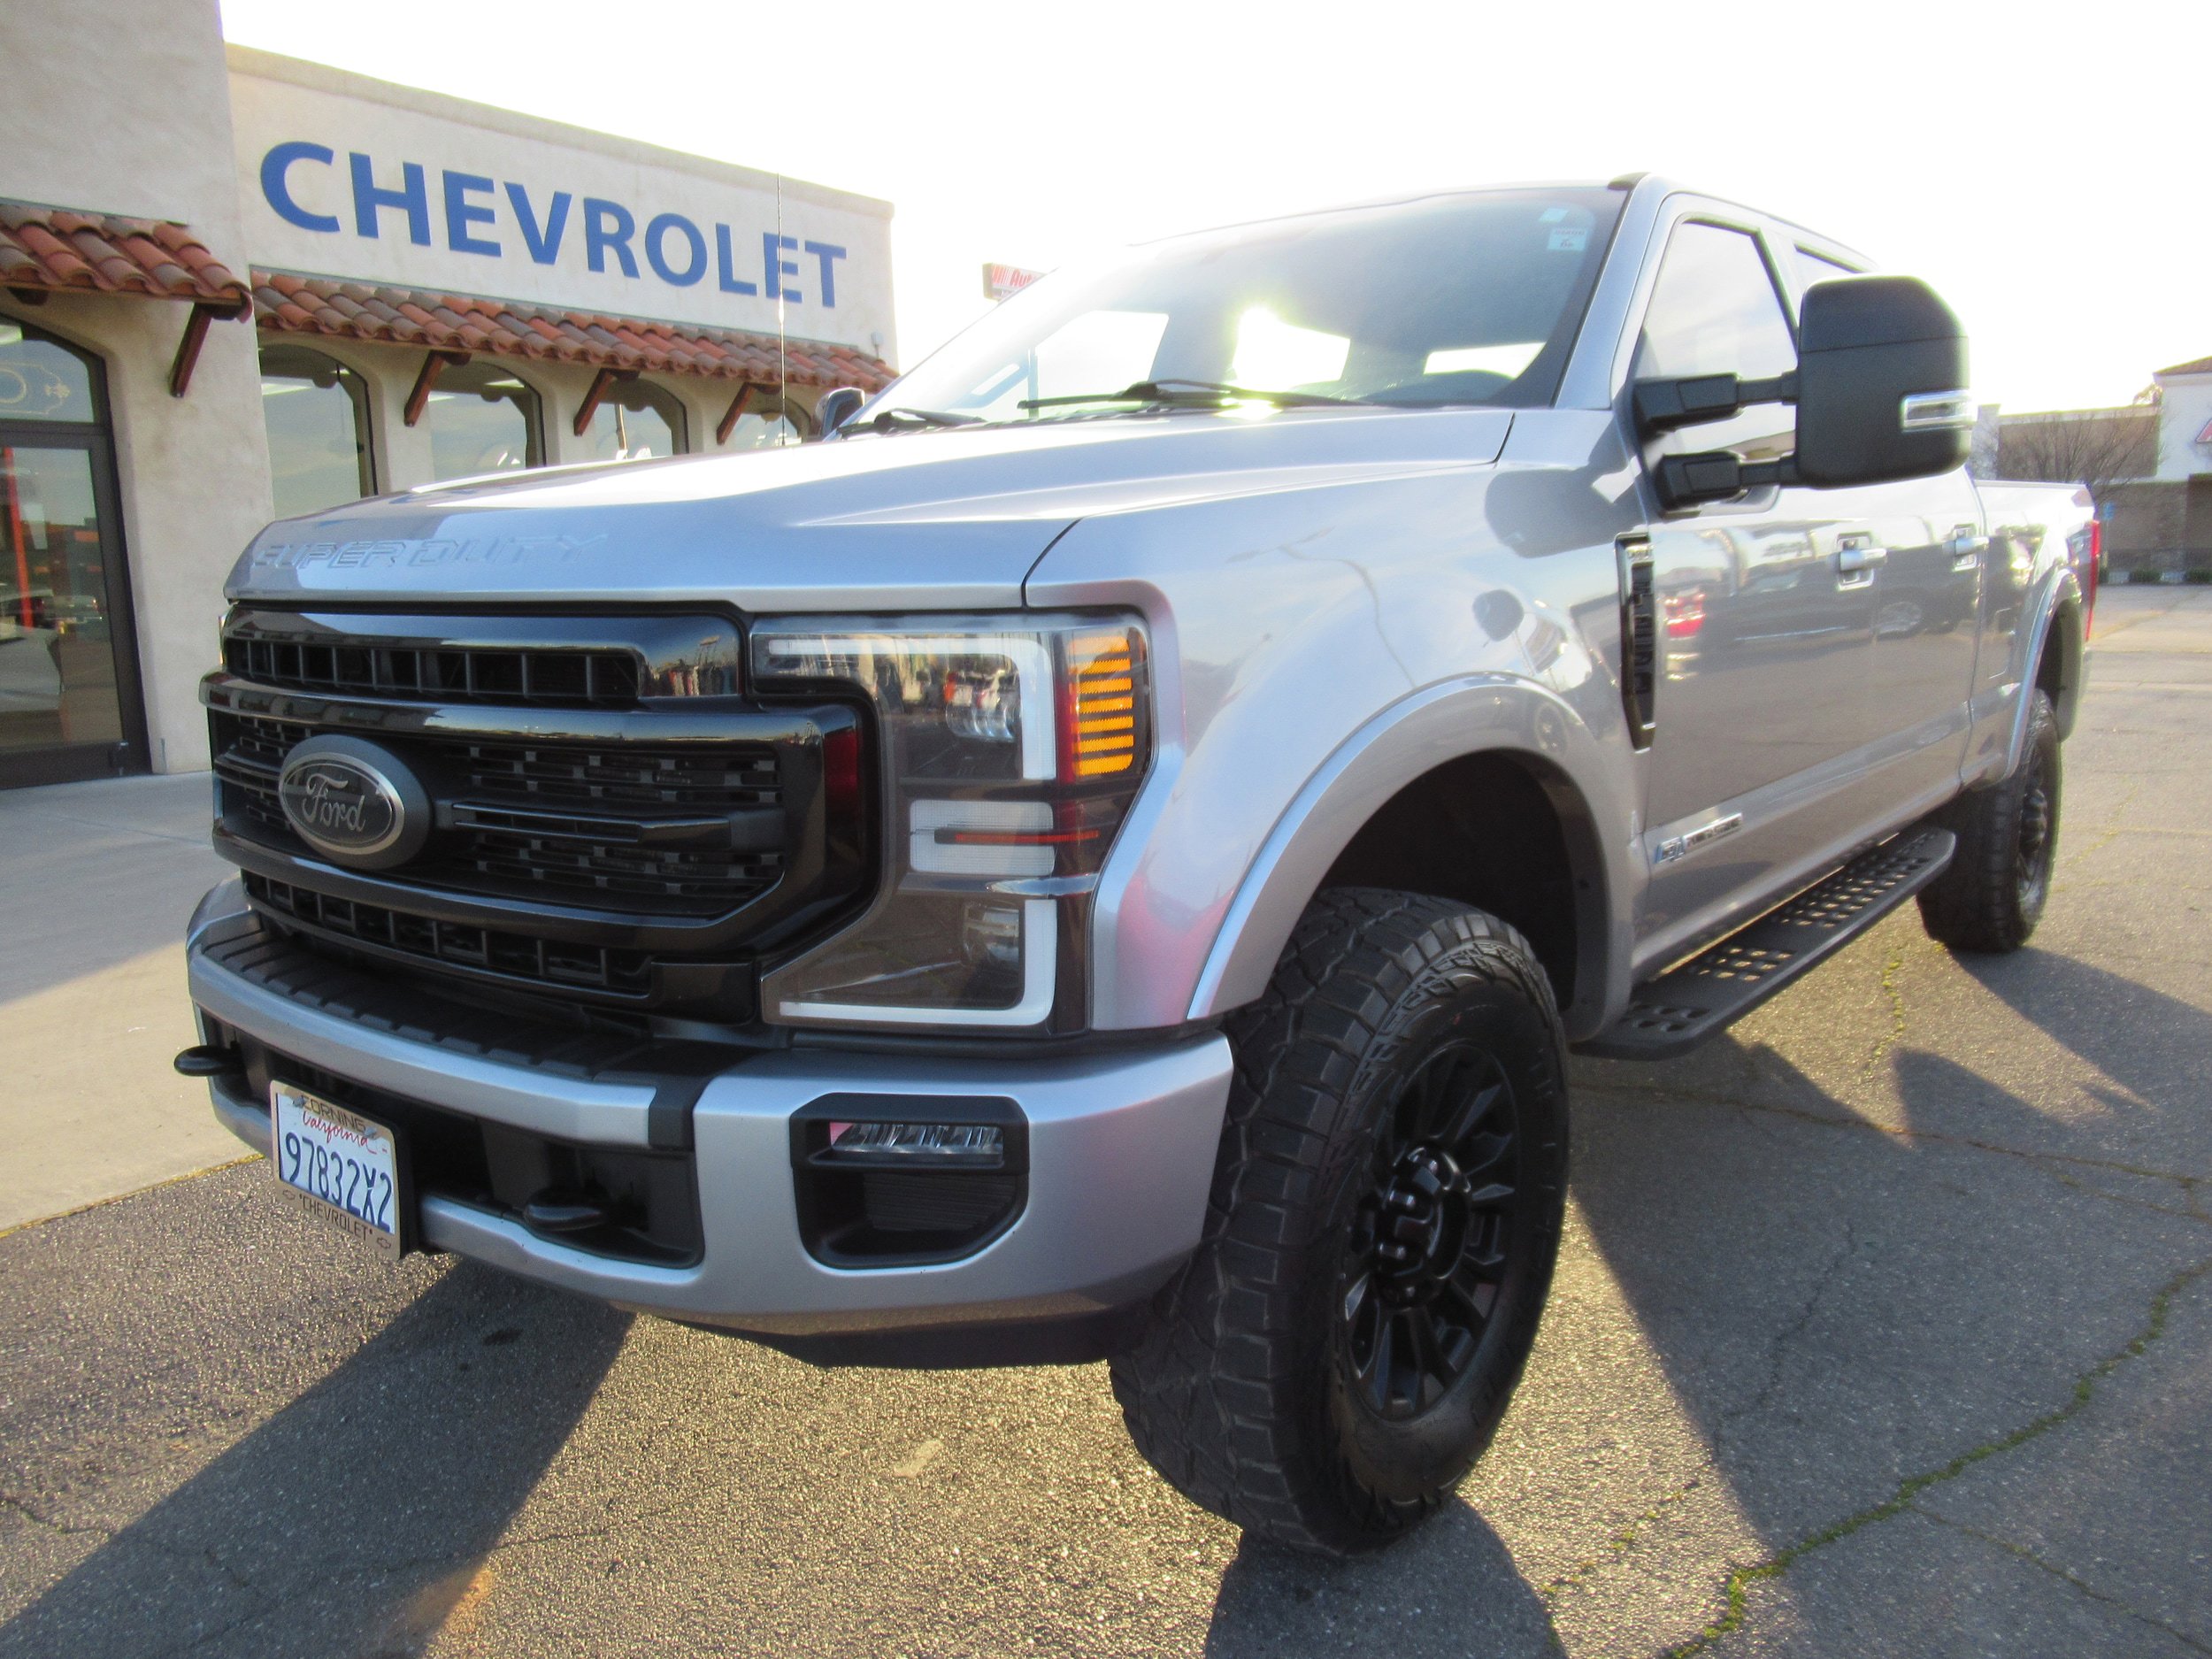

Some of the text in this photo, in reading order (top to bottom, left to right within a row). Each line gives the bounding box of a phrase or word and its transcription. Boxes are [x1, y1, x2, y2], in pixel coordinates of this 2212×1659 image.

[260, 141, 847, 309] CHEVROLET
[252, 534, 610, 569] SUPER DUTY
[302, 772, 367, 833] Ford
[301, 1094, 367, 1134] CORNING
[303, 1110, 378, 1154] California
[285, 1132, 393, 1233] 97832X2
